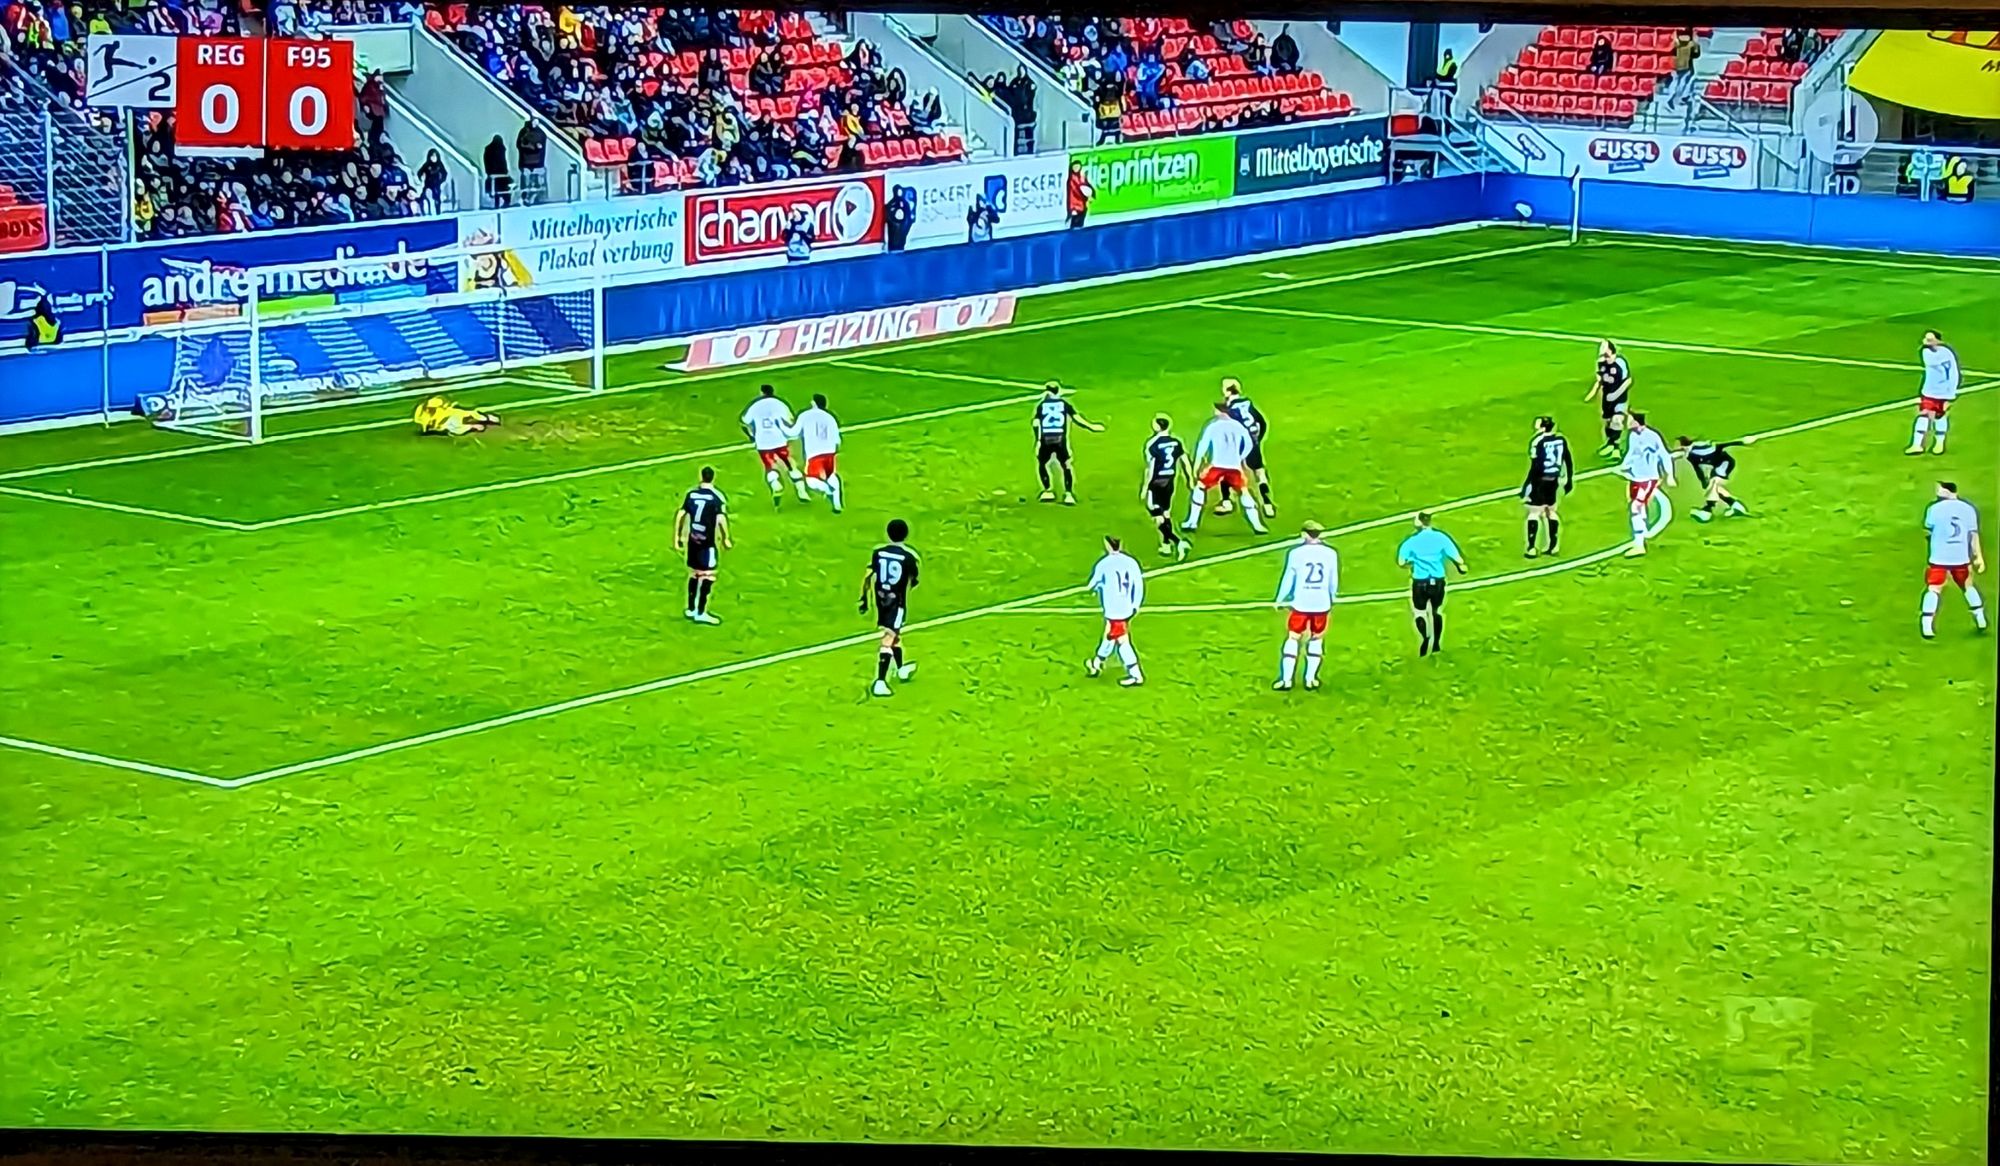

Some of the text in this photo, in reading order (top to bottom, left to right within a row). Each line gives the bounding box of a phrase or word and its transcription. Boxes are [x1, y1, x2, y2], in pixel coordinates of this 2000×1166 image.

[198, 45, 245, 66] REG
[287, 46, 331, 68] F95
[147, 72, 171, 102] 2
[201, 84, 239, 134] 0
[289, 86, 328, 136] 0
[1256, 135, 1384, 177] Mittelbayerische
[1593, 139, 1656, 160] FUSSL
[1678, 145, 1742, 168] FUSSL
[922, 183, 972, 205] ECKERT
[1013, 173, 1063, 194] ECKERT
[529, 206, 678, 241] Mittelbayerische
[793, 308, 921, 354] HEIZUNG
[693, 499, 706, 523] 7
[878, 558, 902, 585] 19
[1304, 561, 1325, 584] 23
